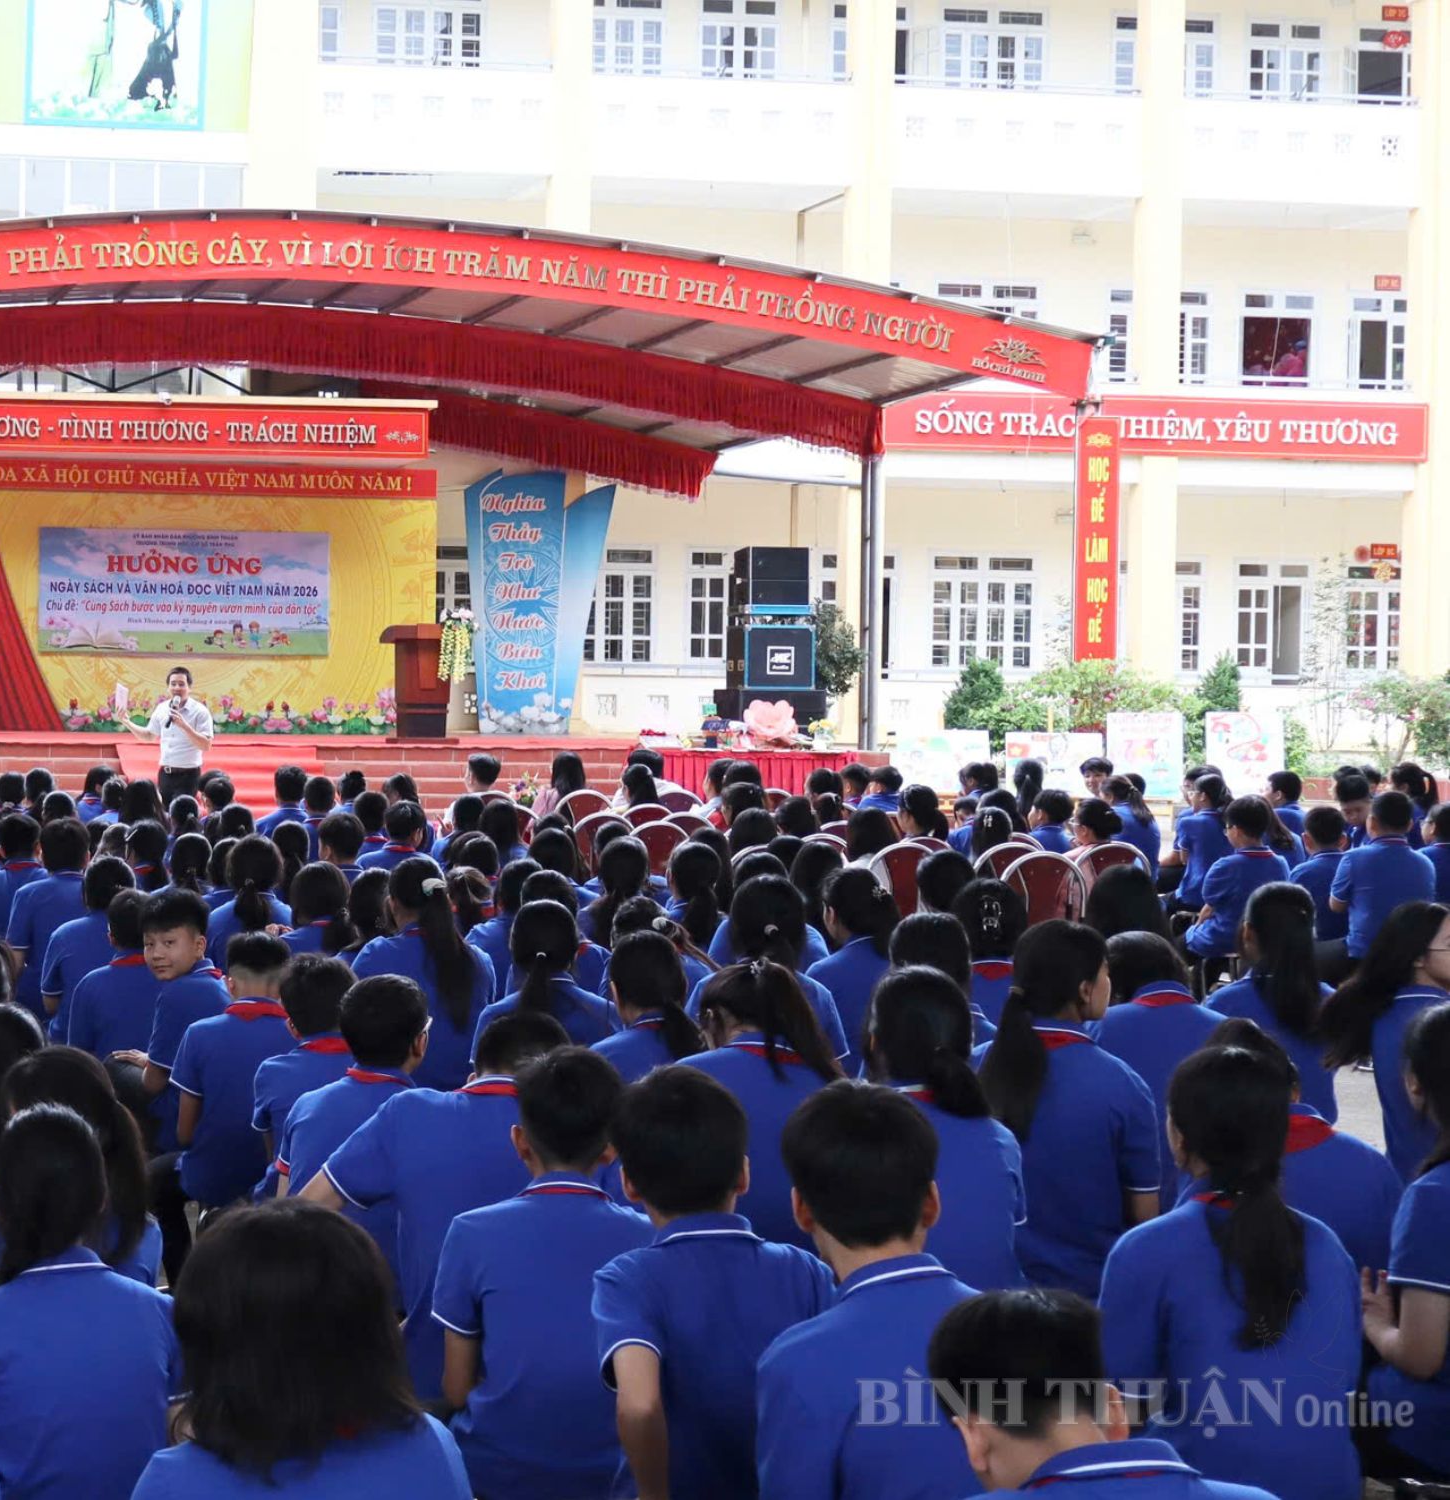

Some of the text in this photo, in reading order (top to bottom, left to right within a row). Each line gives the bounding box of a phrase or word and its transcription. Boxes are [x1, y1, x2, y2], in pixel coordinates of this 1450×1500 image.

[7, 234, 85, 275] PHẢI
[91, 227, 200, 269] TRỒNG
[207, 232, 272, 268] CÂY,
[279, 232, 313, 267] VÌ
[321, 239, 374, 275] LỢI
[382, 238, 437, 274] ÍCH
[443, 246, 531, 282] TRĂM
[538, 255, 608, 291] NĂM
[617, 264, 669, 301] THÌ
[677, 274, 752, 313] PHẢI
[756, 285, 856, 332] TRỒNG
[861, 312, 955, 354] NGƯỜI
[58, 412, 113, 440] TÌNH
[119, 418, 209, 442] THƯƠNG
[226, 416, 298, 443] TRÁCH
[303, 418, 377, 448] NHIỆM
[915, 399, 995, 436] SỐNG
[1001, 406, 1076, 438] TRÁC
[1119, 409, 1212, 446] HIỆM,
[1279, 417, 1399, 446] THƯƠNG
[23, 464, 50, 483] XÃ
[54, 464, 89, 487] HỘI
[94, 463, 134, 485] CHỦ
[140, 467, 200, 487] NGHĨA
[205, 468, 250, 491] VIỆT
[254, 473, 295, 489] NAM
[300, 471, 359, 490] MUÔN
[360, 472, 402, 491] NĂM
[1088, 457, 1110, 488] HỌC
[481, 493, 546, 516] Nghĩa
[1090, 487, 1106, 522] ĐỂ
[489, 522, 542, 543] Thầy
[1085, 532, 1109, 563] LÀM
[106, 549, 263, 575] HƯỞNG ỨNG
[498, 552, 535, 571] Trò
[50, 579, 318, 599] NGÀY SÁCH VÀ VĂN HOÁ ĐỌC VIỆT NAM NĂM 2026
[493, 581, 542, 601] Như
[1087, 578, 1108, 609] HỌC
[46, 598, 62, 611] Chủ
[64, 598, 79, 611] đề:
[109, 600, 129, 611] Sách
[132, 600, 154, 612] bước
[156, 601, 172, 612] vào
[186, 603, 217, 616] nguyên
[220, 604, 242, 613] vươn
[244, 603, 265, 614] mình
[268, 602, 283, 614] của
[285, 603, 301, 615] dân
[492, 611, 545, 631] Nước
[1087, 607, 1104, 643] ĐỂ
[498, 640, 542, 660] Biển
[493, 670, 546, 690] Khơi
